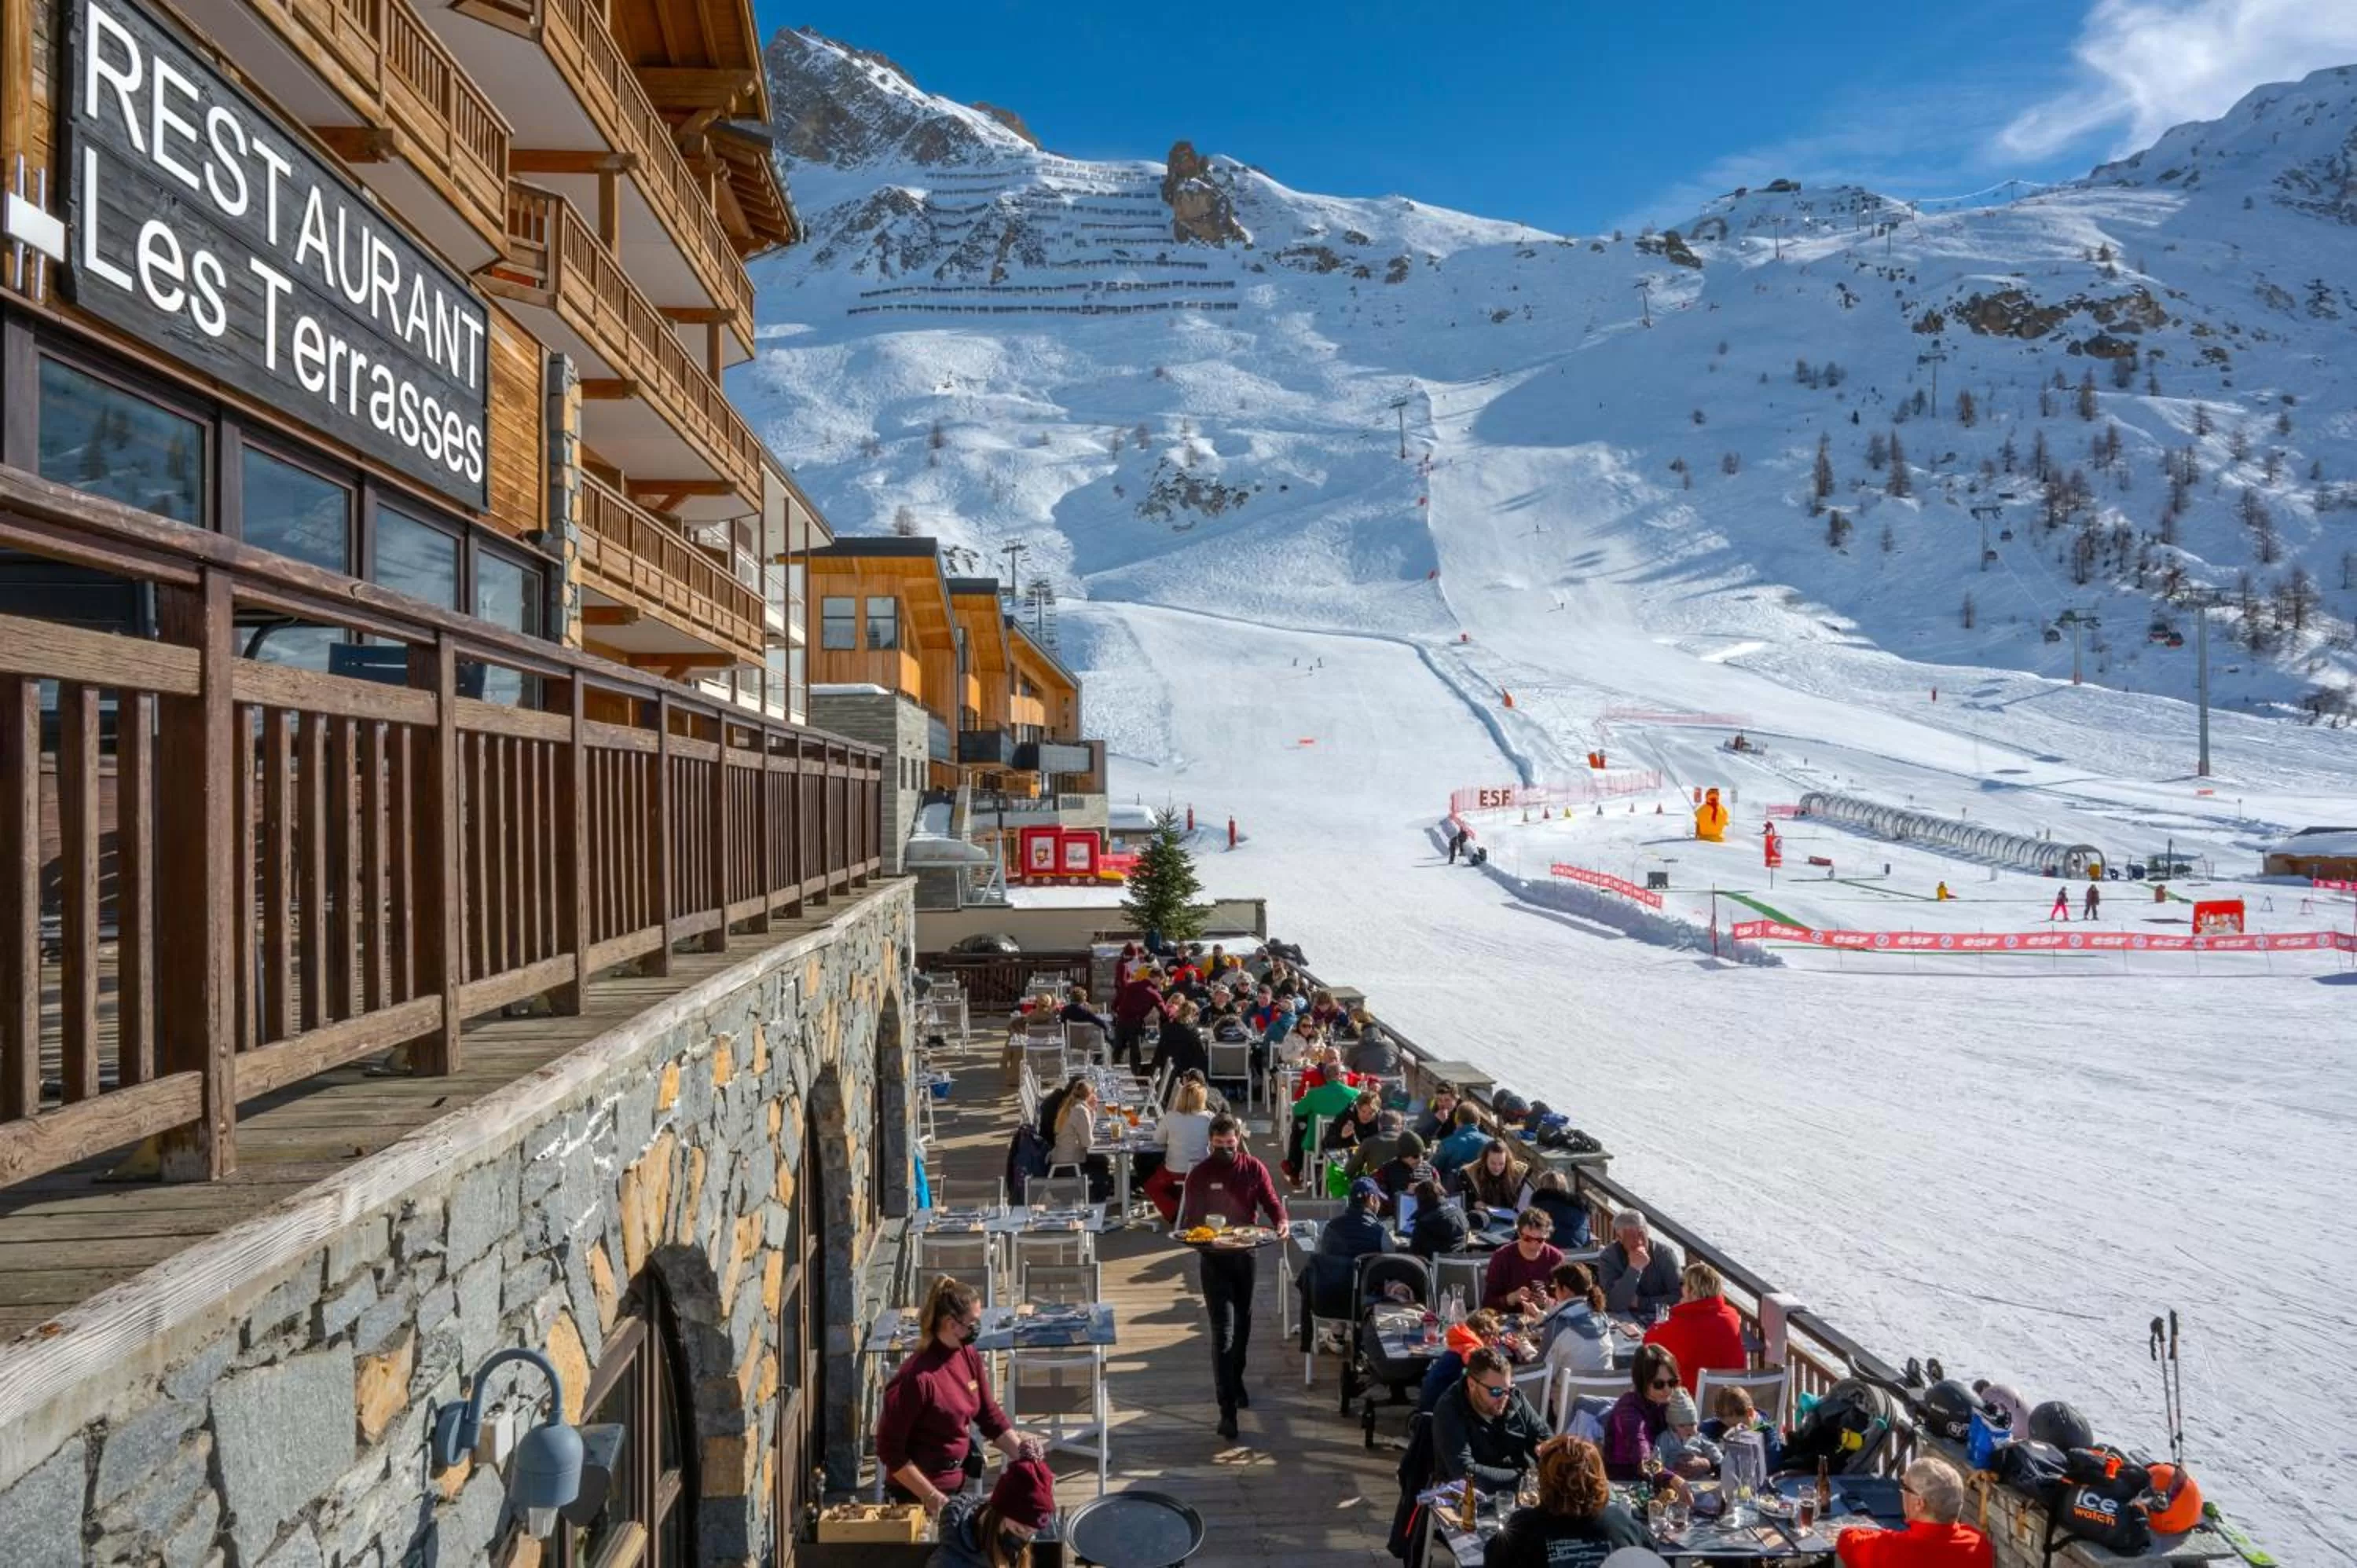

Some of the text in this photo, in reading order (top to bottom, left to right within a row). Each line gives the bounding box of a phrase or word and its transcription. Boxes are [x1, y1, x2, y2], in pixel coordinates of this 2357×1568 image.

[87, 2, 484, 389] RESTAURANT
[83, 145, 482, 483] Les Terrasses
[1479, 789, 1510, 807] ESF
[2074, 1507, 2116, 1526] watch
